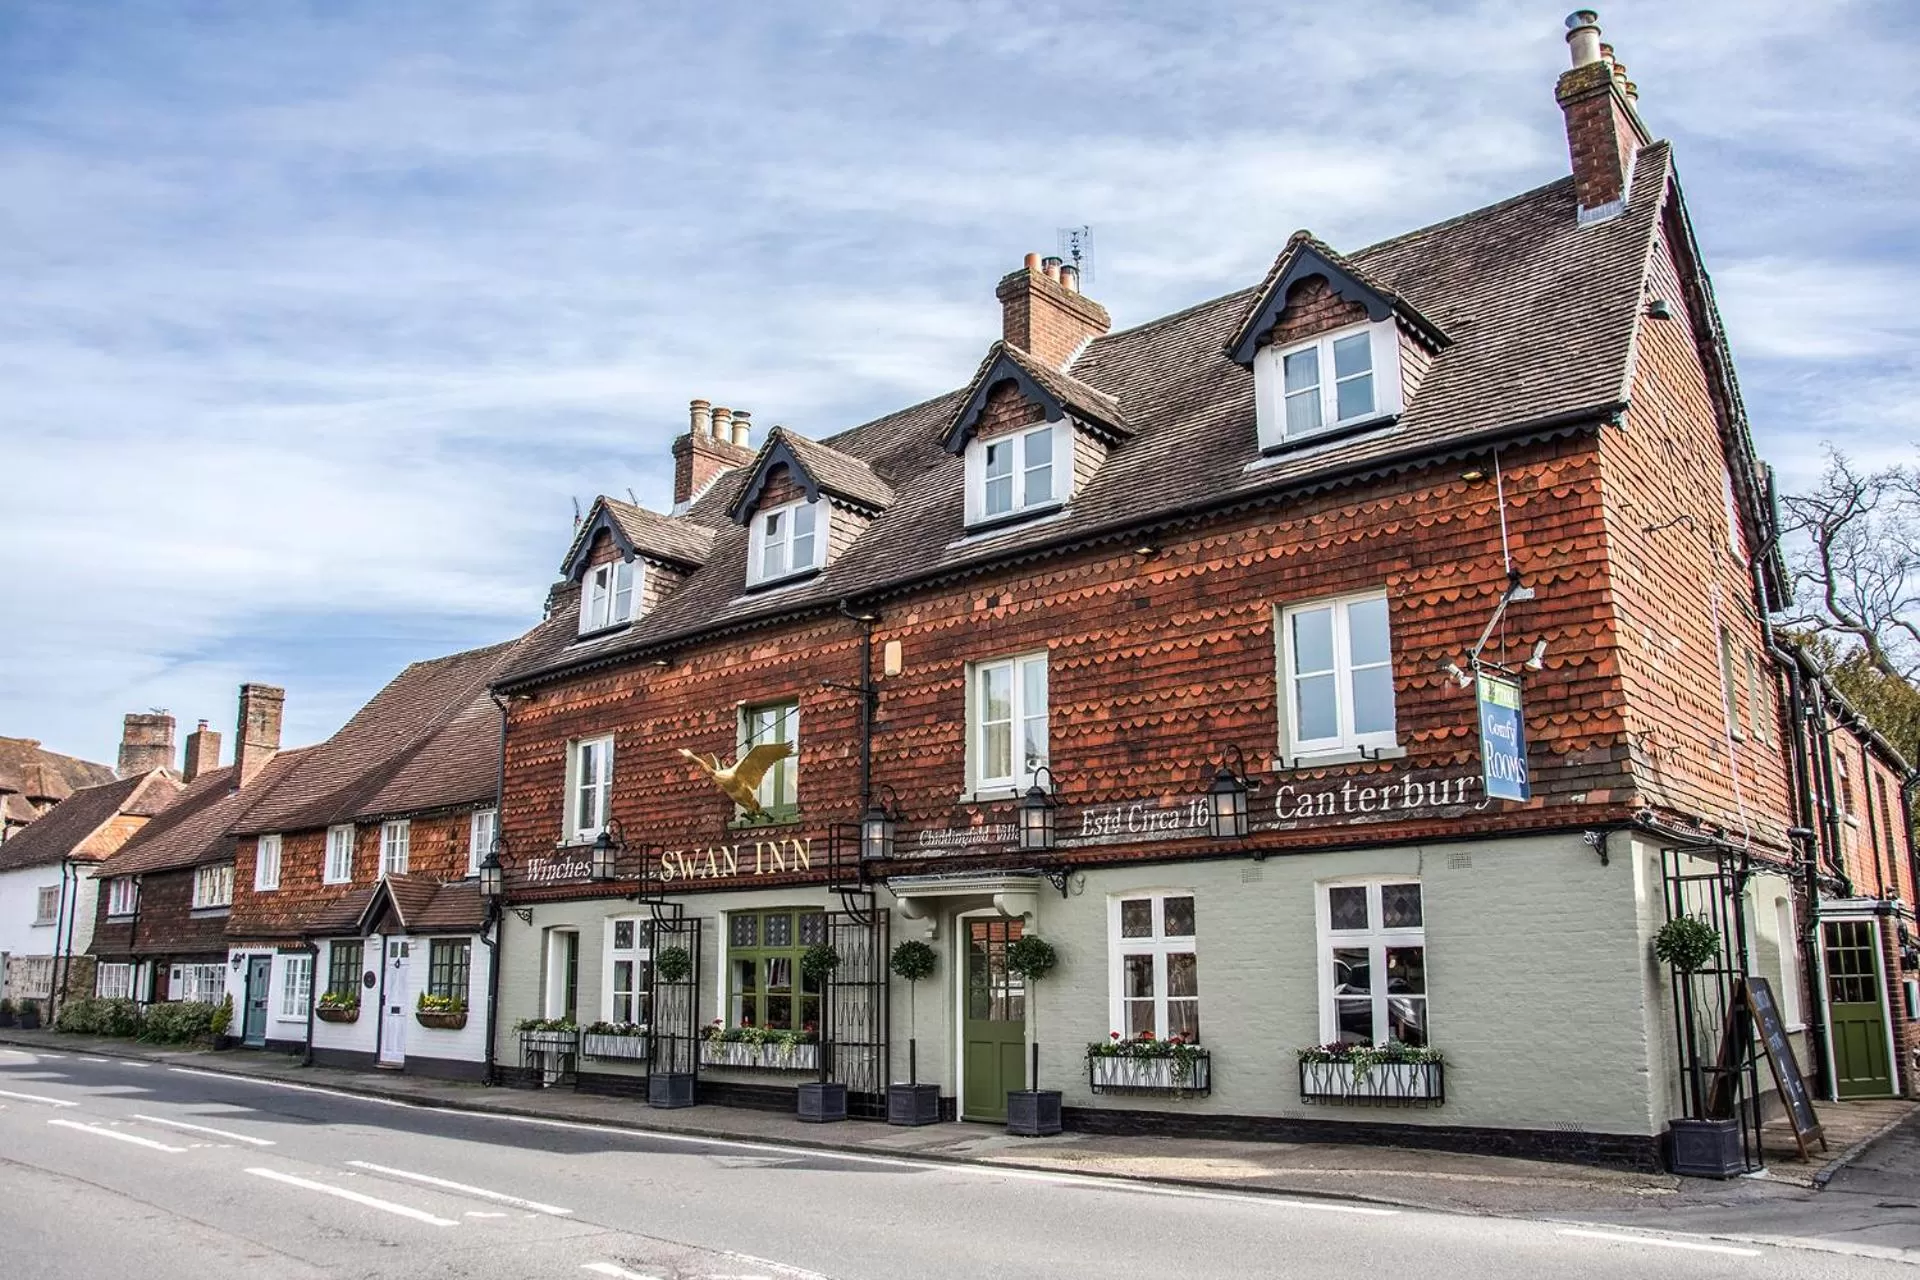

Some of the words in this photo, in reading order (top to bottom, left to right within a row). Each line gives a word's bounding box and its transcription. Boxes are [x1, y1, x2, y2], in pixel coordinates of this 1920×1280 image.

[1127, 804, 1179, 833] Circa
[660, 845, 739, 880] SWAN
[751, 838, 811, 874] INN
